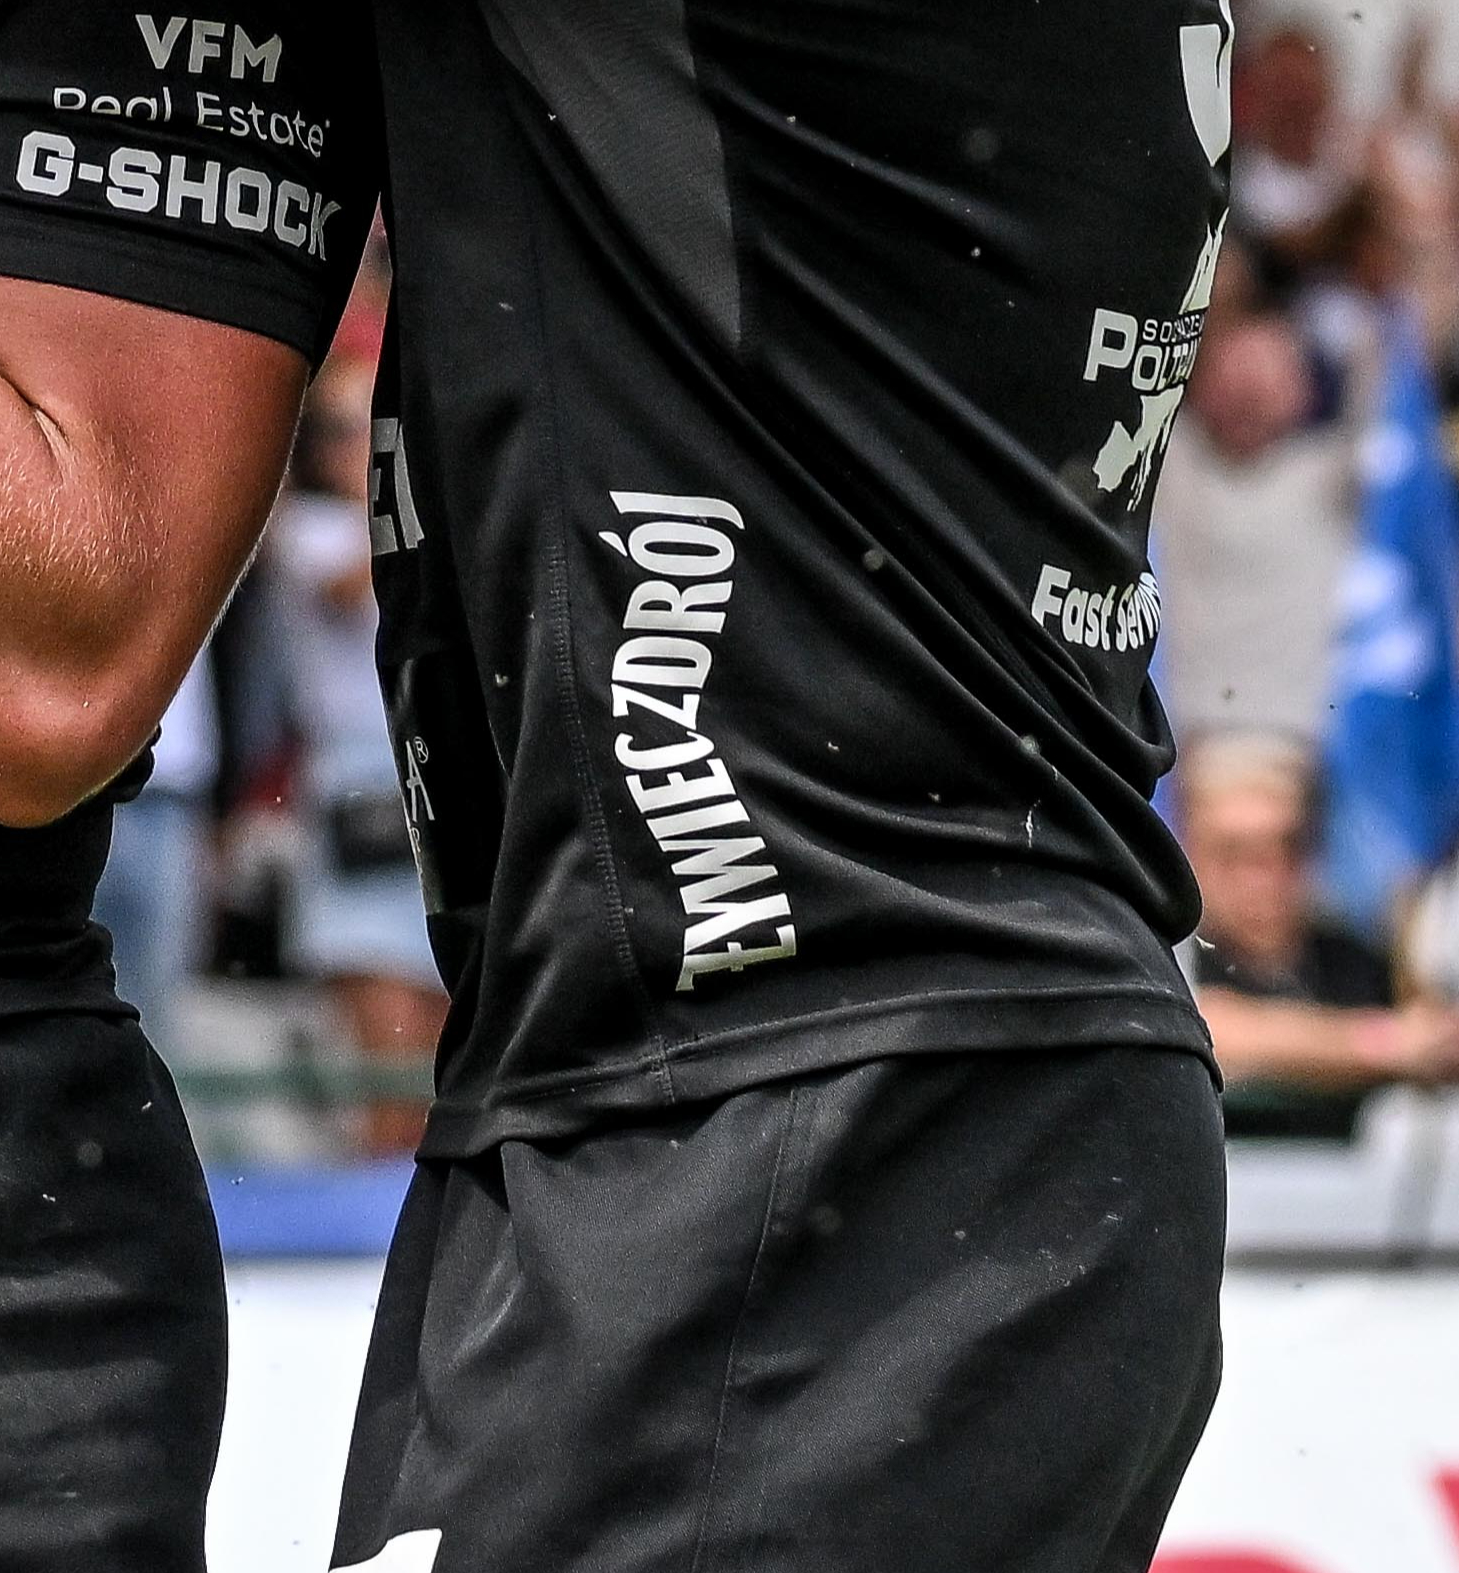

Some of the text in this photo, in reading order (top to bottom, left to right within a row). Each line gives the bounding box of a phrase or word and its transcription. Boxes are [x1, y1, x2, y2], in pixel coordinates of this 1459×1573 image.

[134, 13, 283, 83] VFM
[15, 130, 342, 261] G-SHOCK
[1031, 563, 1117, 651] Fast
